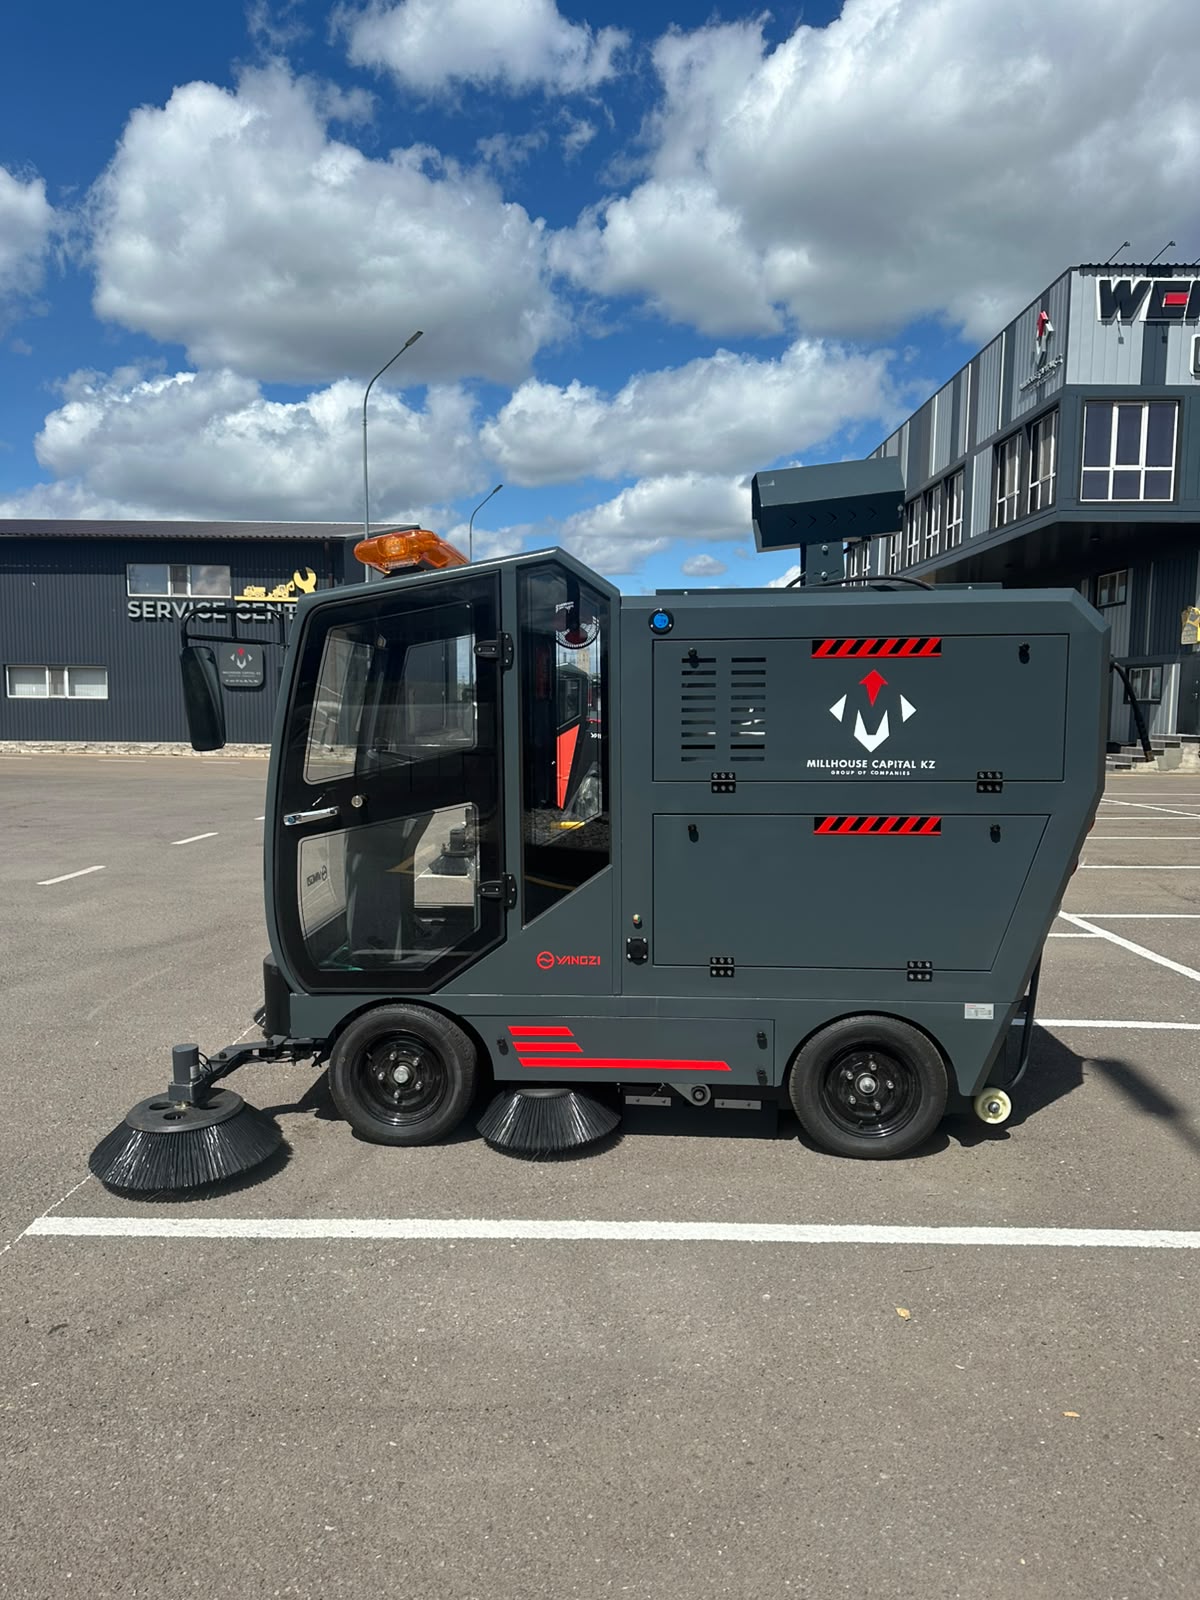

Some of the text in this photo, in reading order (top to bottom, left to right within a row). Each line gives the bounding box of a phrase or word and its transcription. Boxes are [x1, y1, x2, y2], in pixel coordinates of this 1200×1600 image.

[128, 601, 226, 619] SERVICE
[807, 760, 936, 769] MILLHOUSE CAPITAL KZ
[556, 955, 600, 965] YANGZI
